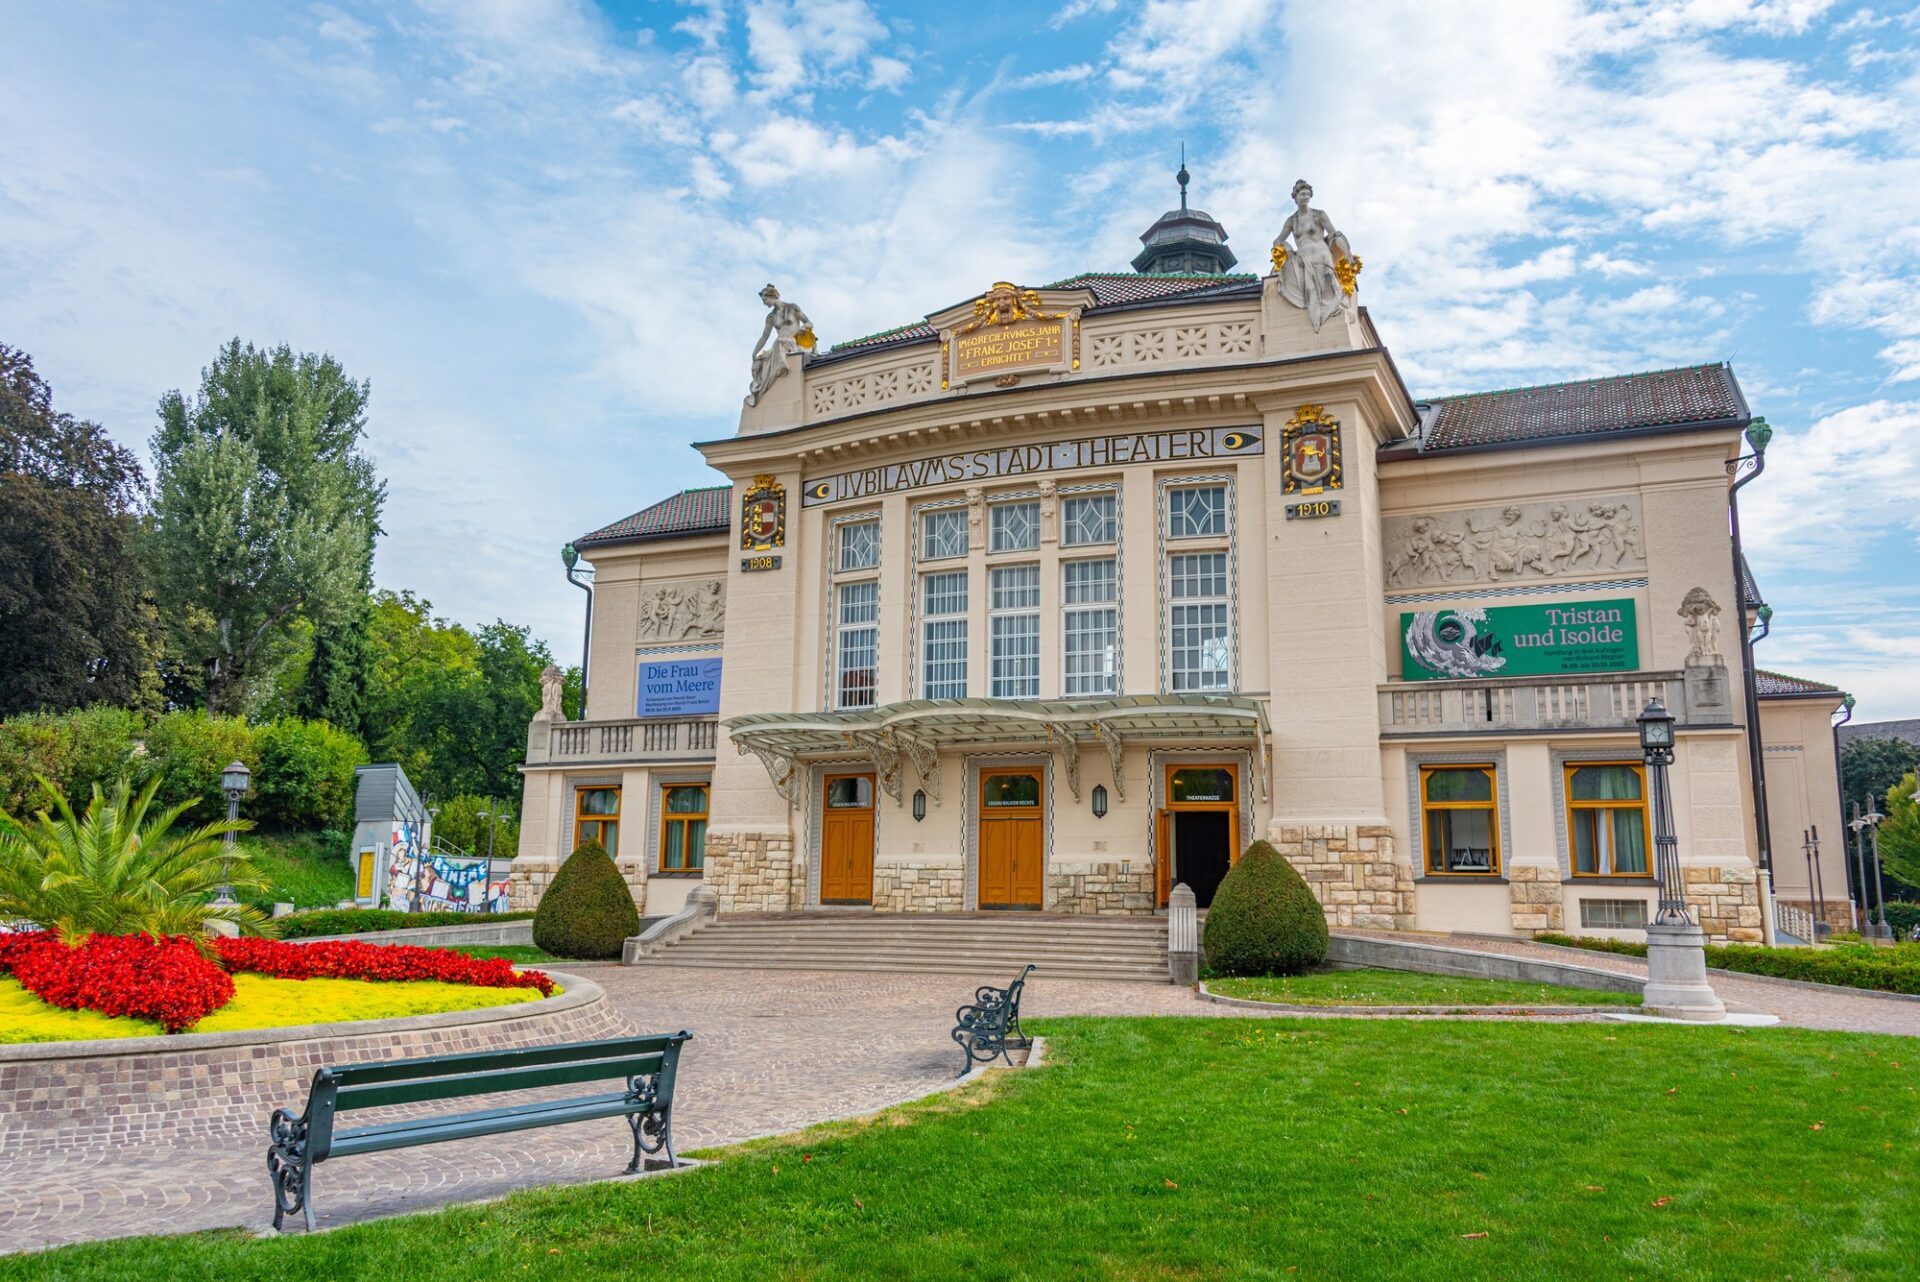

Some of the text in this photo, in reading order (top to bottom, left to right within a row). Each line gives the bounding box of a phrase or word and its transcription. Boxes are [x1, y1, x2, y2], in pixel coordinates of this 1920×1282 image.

[1036, 325, 1061, 336] JAHR
[966, 343, 1004, 359] FRANZ
[1005, 337, 1044, 353] JOSEF
[981, 351, 1032, 367] ERRICHTET
[1297, 502, 1329, 517] 1910
[749, 557, 773, 570] 1908
[1545, 608, 1622, 626] Tristan
[1513, 625, 1623, 648] und Isolde
[647, 664, 698, 680] Die Frau
[646, 680, 715, 694] vom Meere
